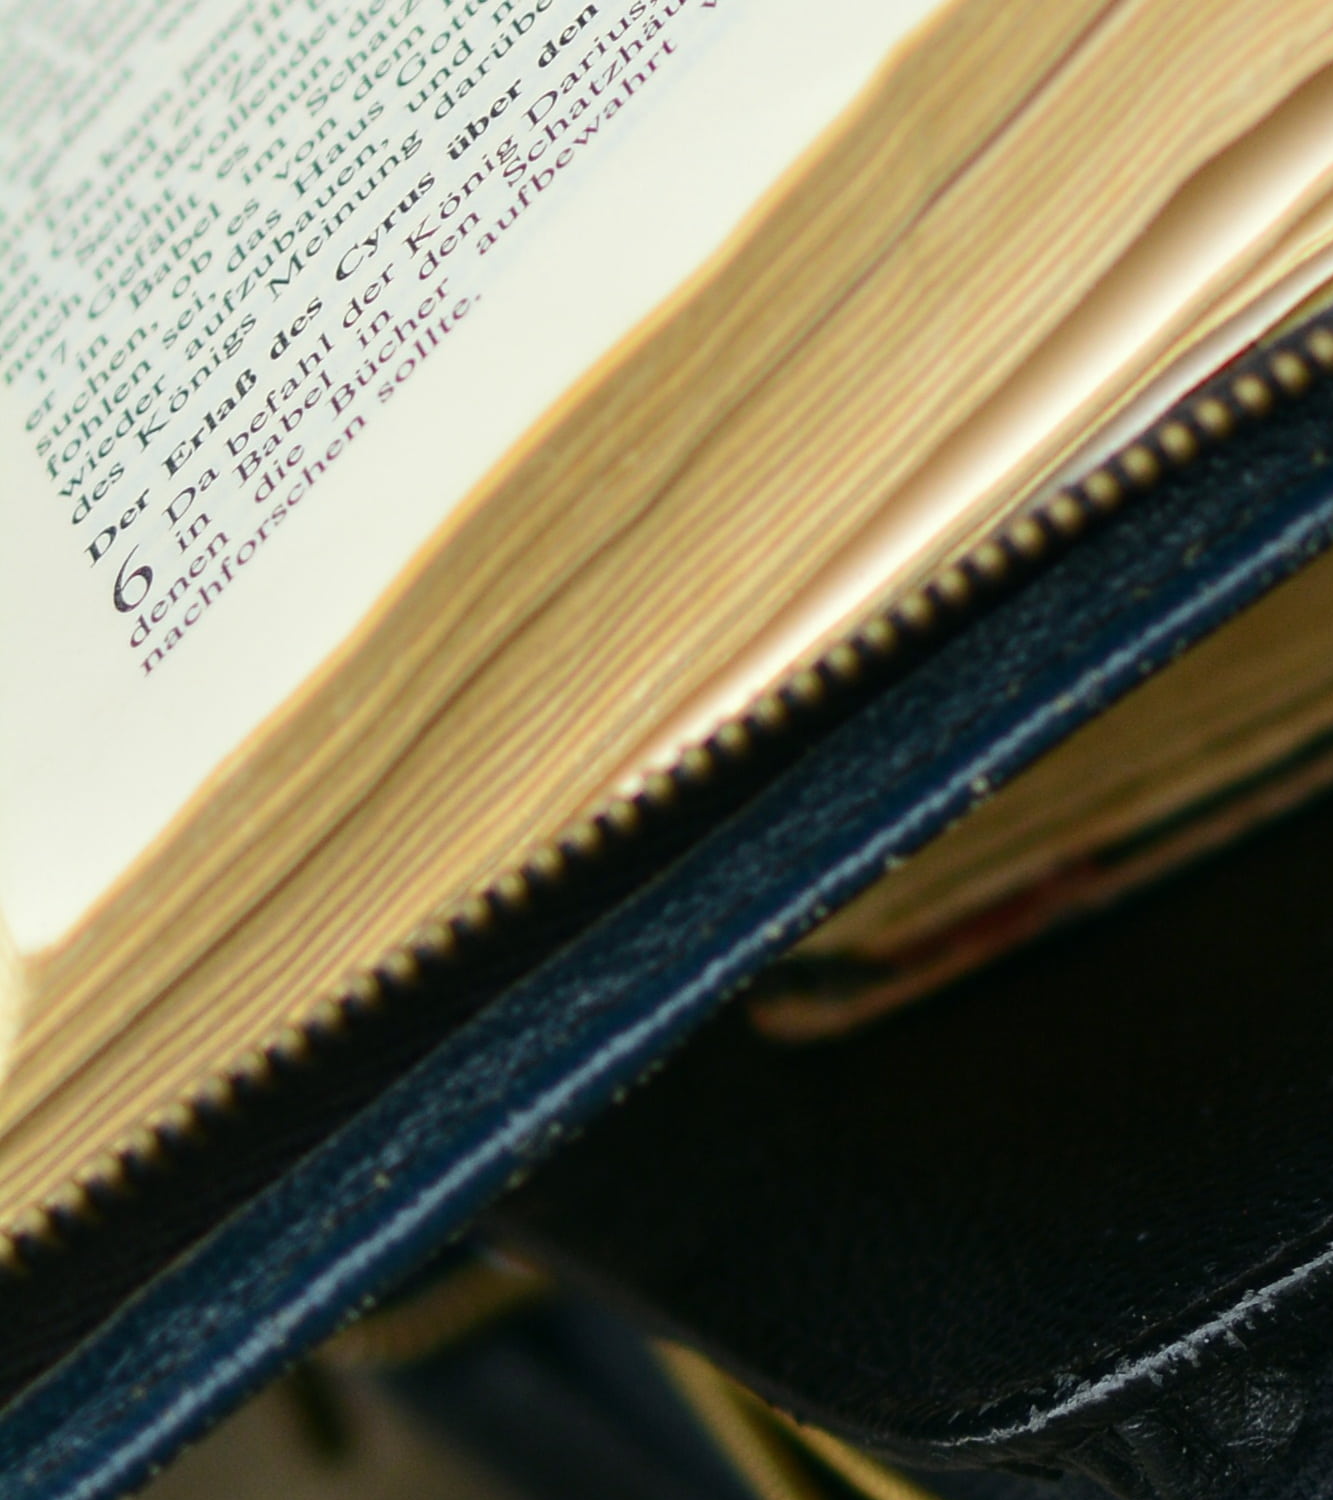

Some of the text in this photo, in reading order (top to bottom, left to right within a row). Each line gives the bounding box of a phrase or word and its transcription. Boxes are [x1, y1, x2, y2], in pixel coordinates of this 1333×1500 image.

[57, 373, 166, 498] wieder
[184, 137, 390, 362] aufzubauen,
[405, 37, 475, 114] und
[70, 461, 126, 526] des
[135, 312, 258, 451] Königs
[266, 128, 424, 300] Meinung
[85, 487, 151, 566] Der
[161, 367, 258, 479] Erlaß
[268, 295, 324, 362] des
[334, 170, 436, 283] Cyrus
[446, 77, 523, 162] über
[536, 3, 600, 69] den
[112, 544, 155, 615] 6
[163, 467, 220, 527] Da
[224, 332, 334, 458] befahl
[341, 261, 395, 330] der
[403, 135, 520, 258] König
[128, 531, 230, 650] denen
[253, 443, 303, 505] die
[329, 277, 449, 417] Bücher
[475, 39, 675, 257] aufbewahrt
[140, 293, 482, 676] nachforschen sollte.
[174, 512, 212, 554] in
[234, 369, 334, 484] Babel
[355, 309, 392, 350] in
[417, 211, 482, 282] den
